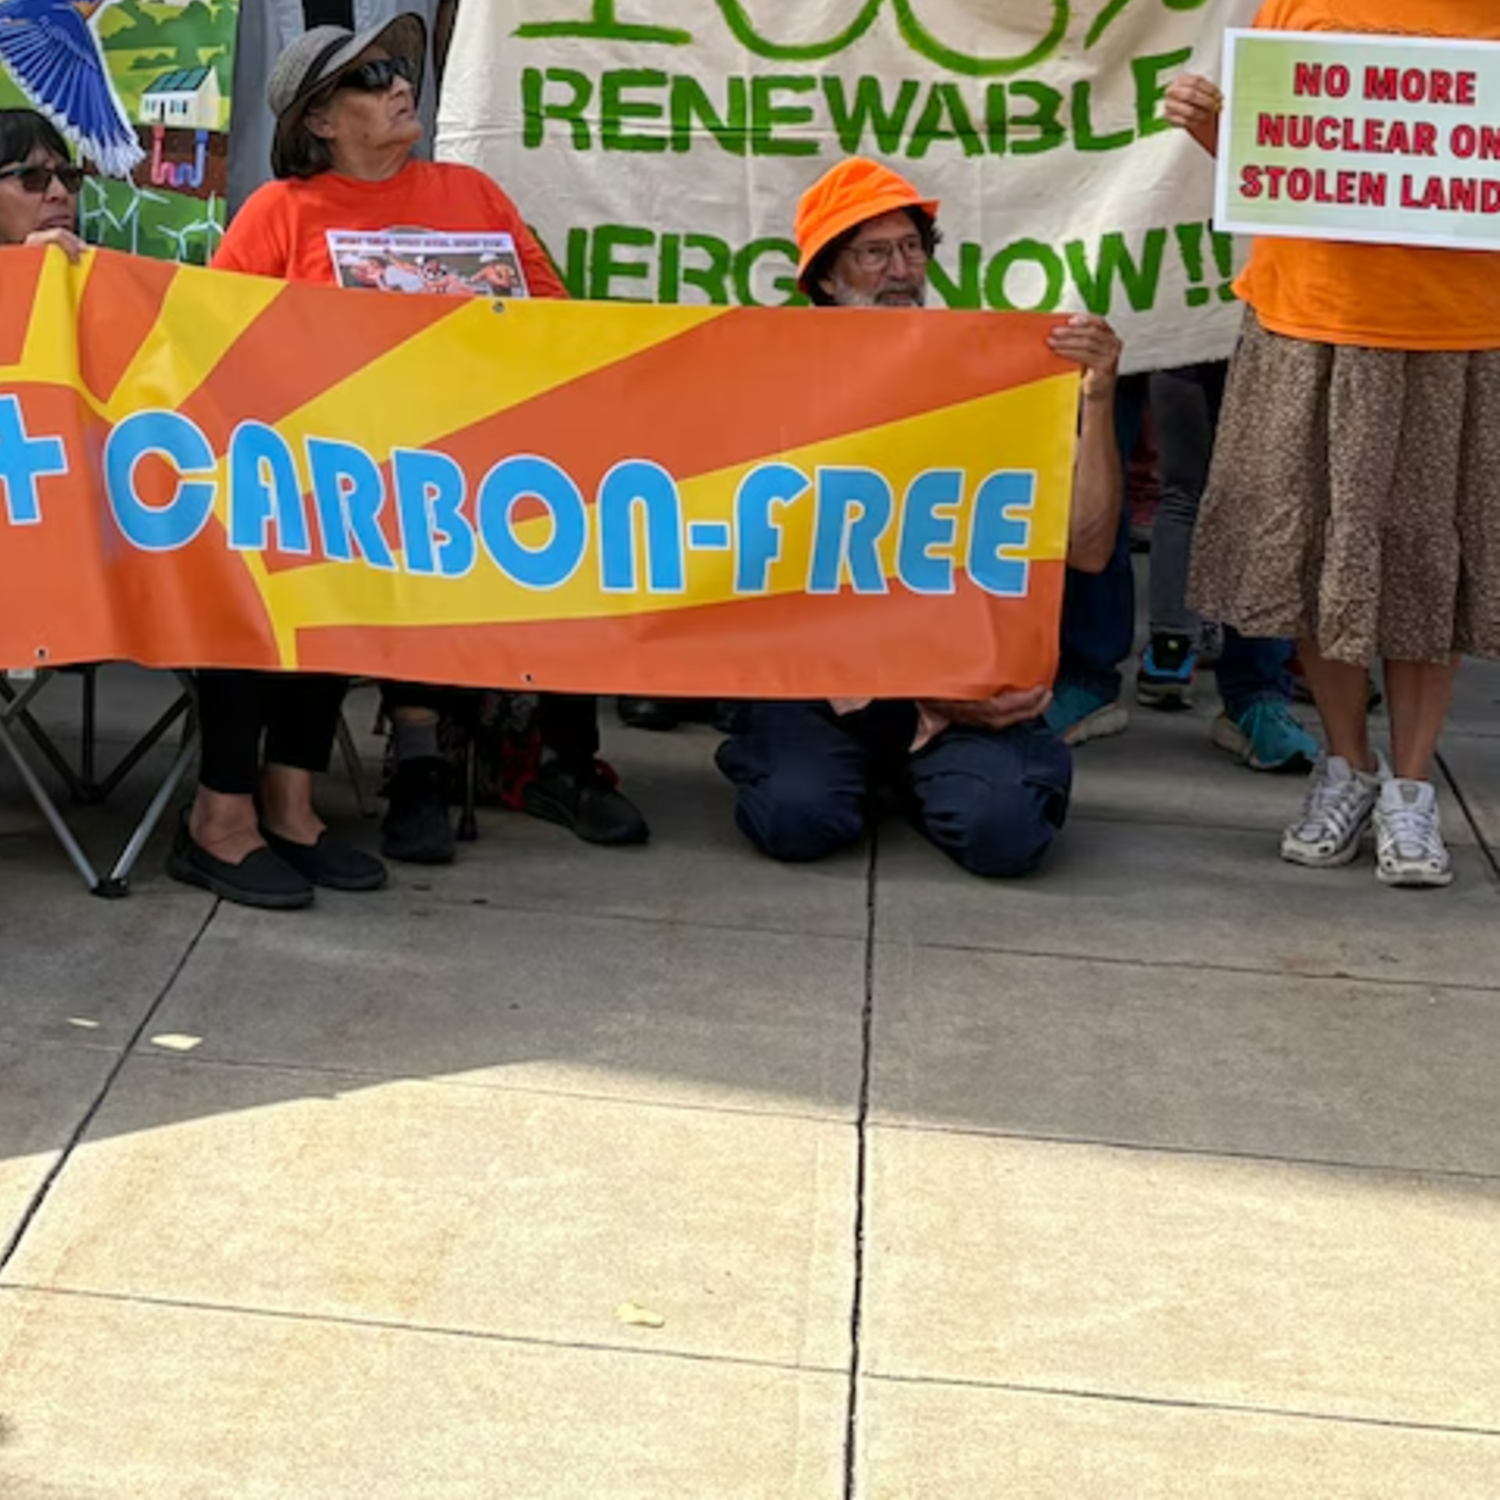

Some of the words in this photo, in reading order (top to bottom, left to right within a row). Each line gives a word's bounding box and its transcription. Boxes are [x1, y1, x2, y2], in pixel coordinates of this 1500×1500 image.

[520, 45, 1194, 159] RENEWABLE
[1293, 62, 1350, 99] NO
[1362, 66, 1477, 107] MORE
[1256, 112, 1438, 157] NUCLEAR
[1449, 124, 1500, 161] ON
[1238, 163, 1387, 207] STOLEN
[1399, 174, 1500, 214] LAND
[528, 222, 803, 309] NERG
[103, 406, 1040, 599] CARBON-FREE
